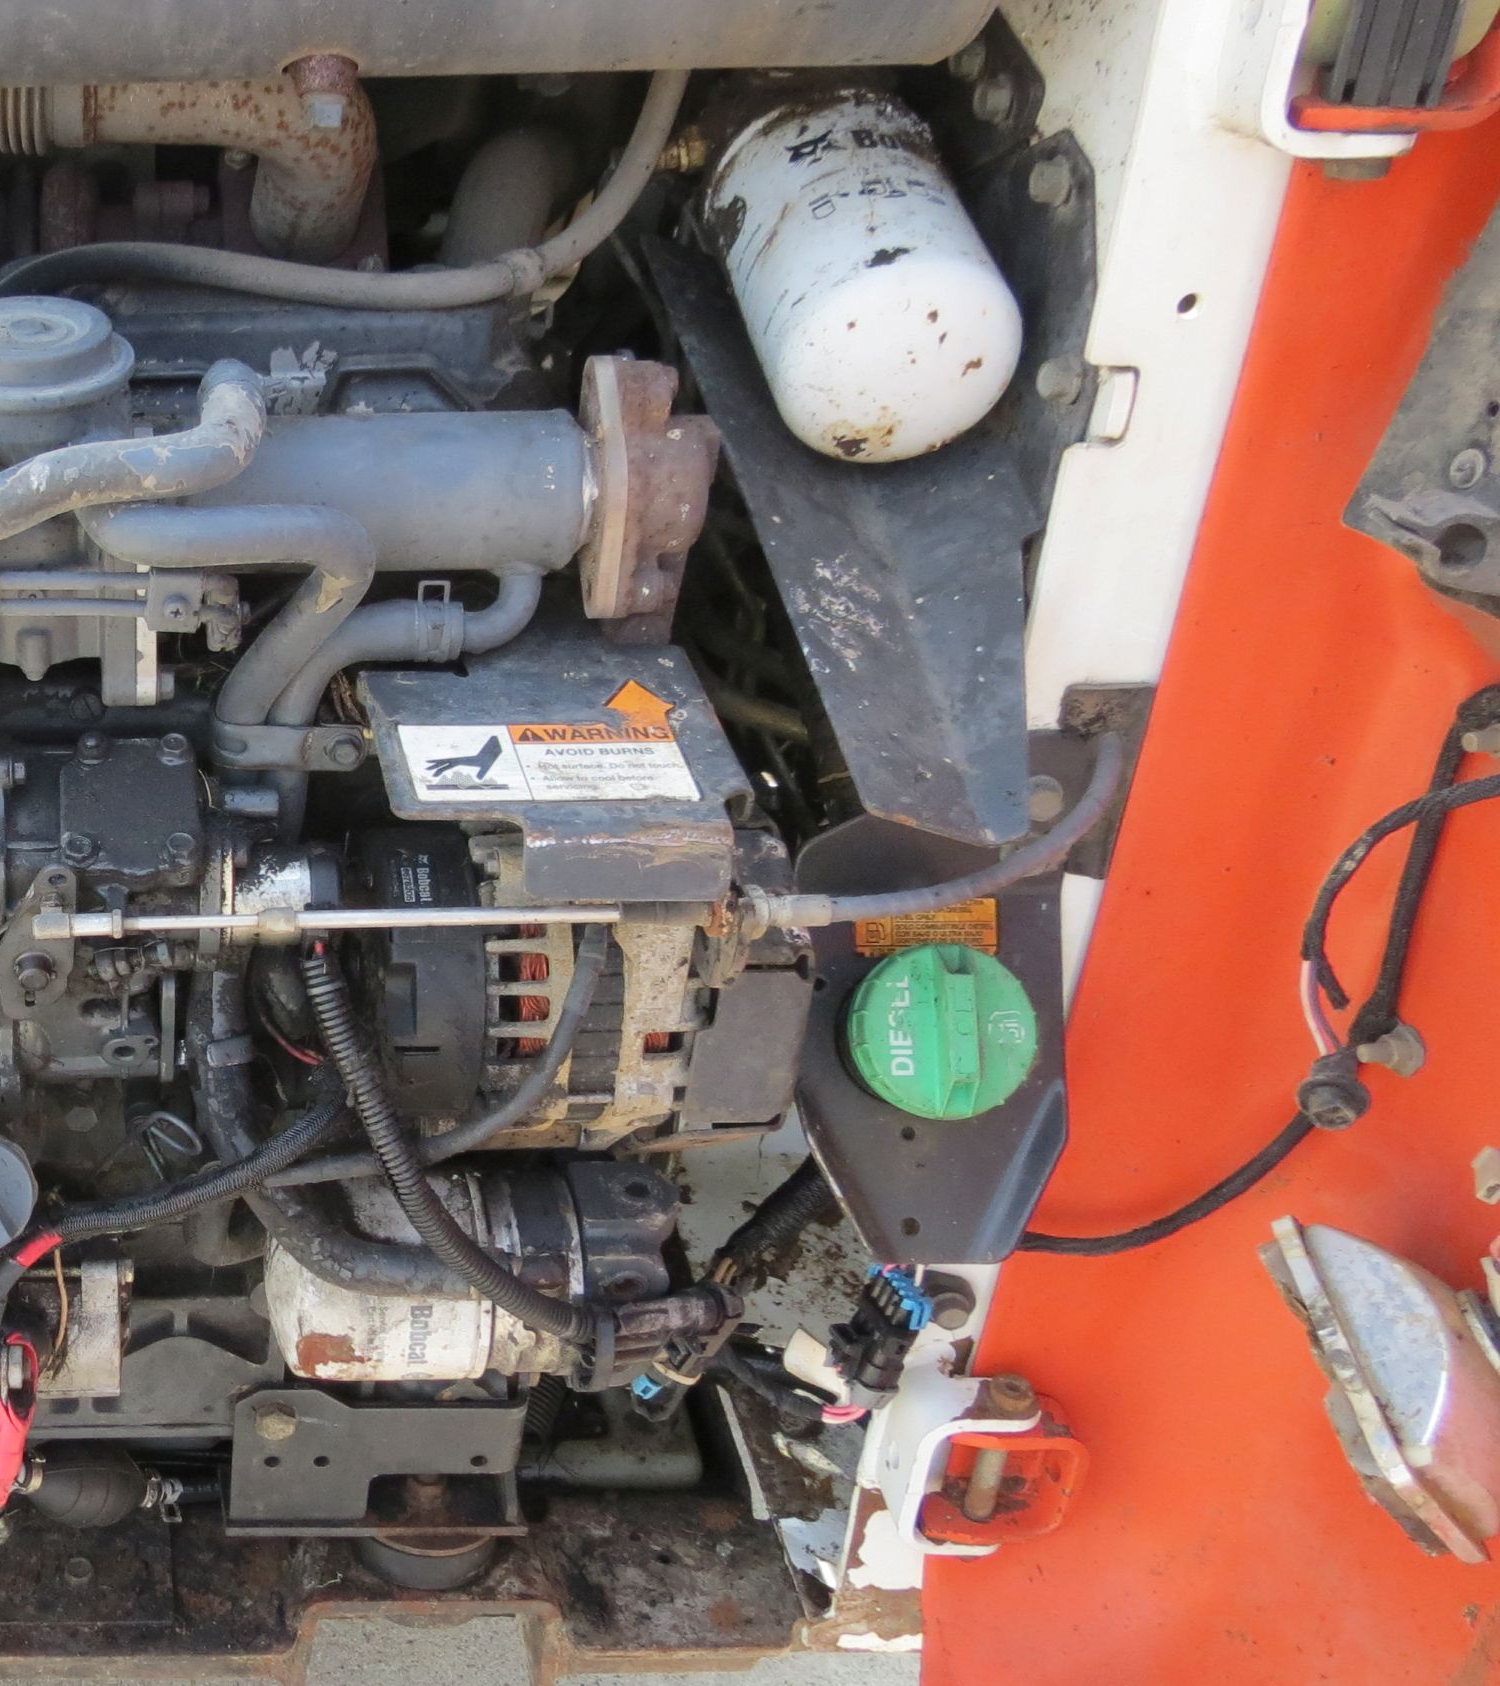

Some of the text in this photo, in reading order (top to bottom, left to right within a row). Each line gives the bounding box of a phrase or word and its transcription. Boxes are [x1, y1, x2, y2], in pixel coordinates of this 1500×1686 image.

[543, 726, 669, 741] WARNING
[545, 746, 655, 757] AVOID BURNS
[417, 867, 433, 902] Bobcat
[406, 1305, 434, 1368] Bobcat
